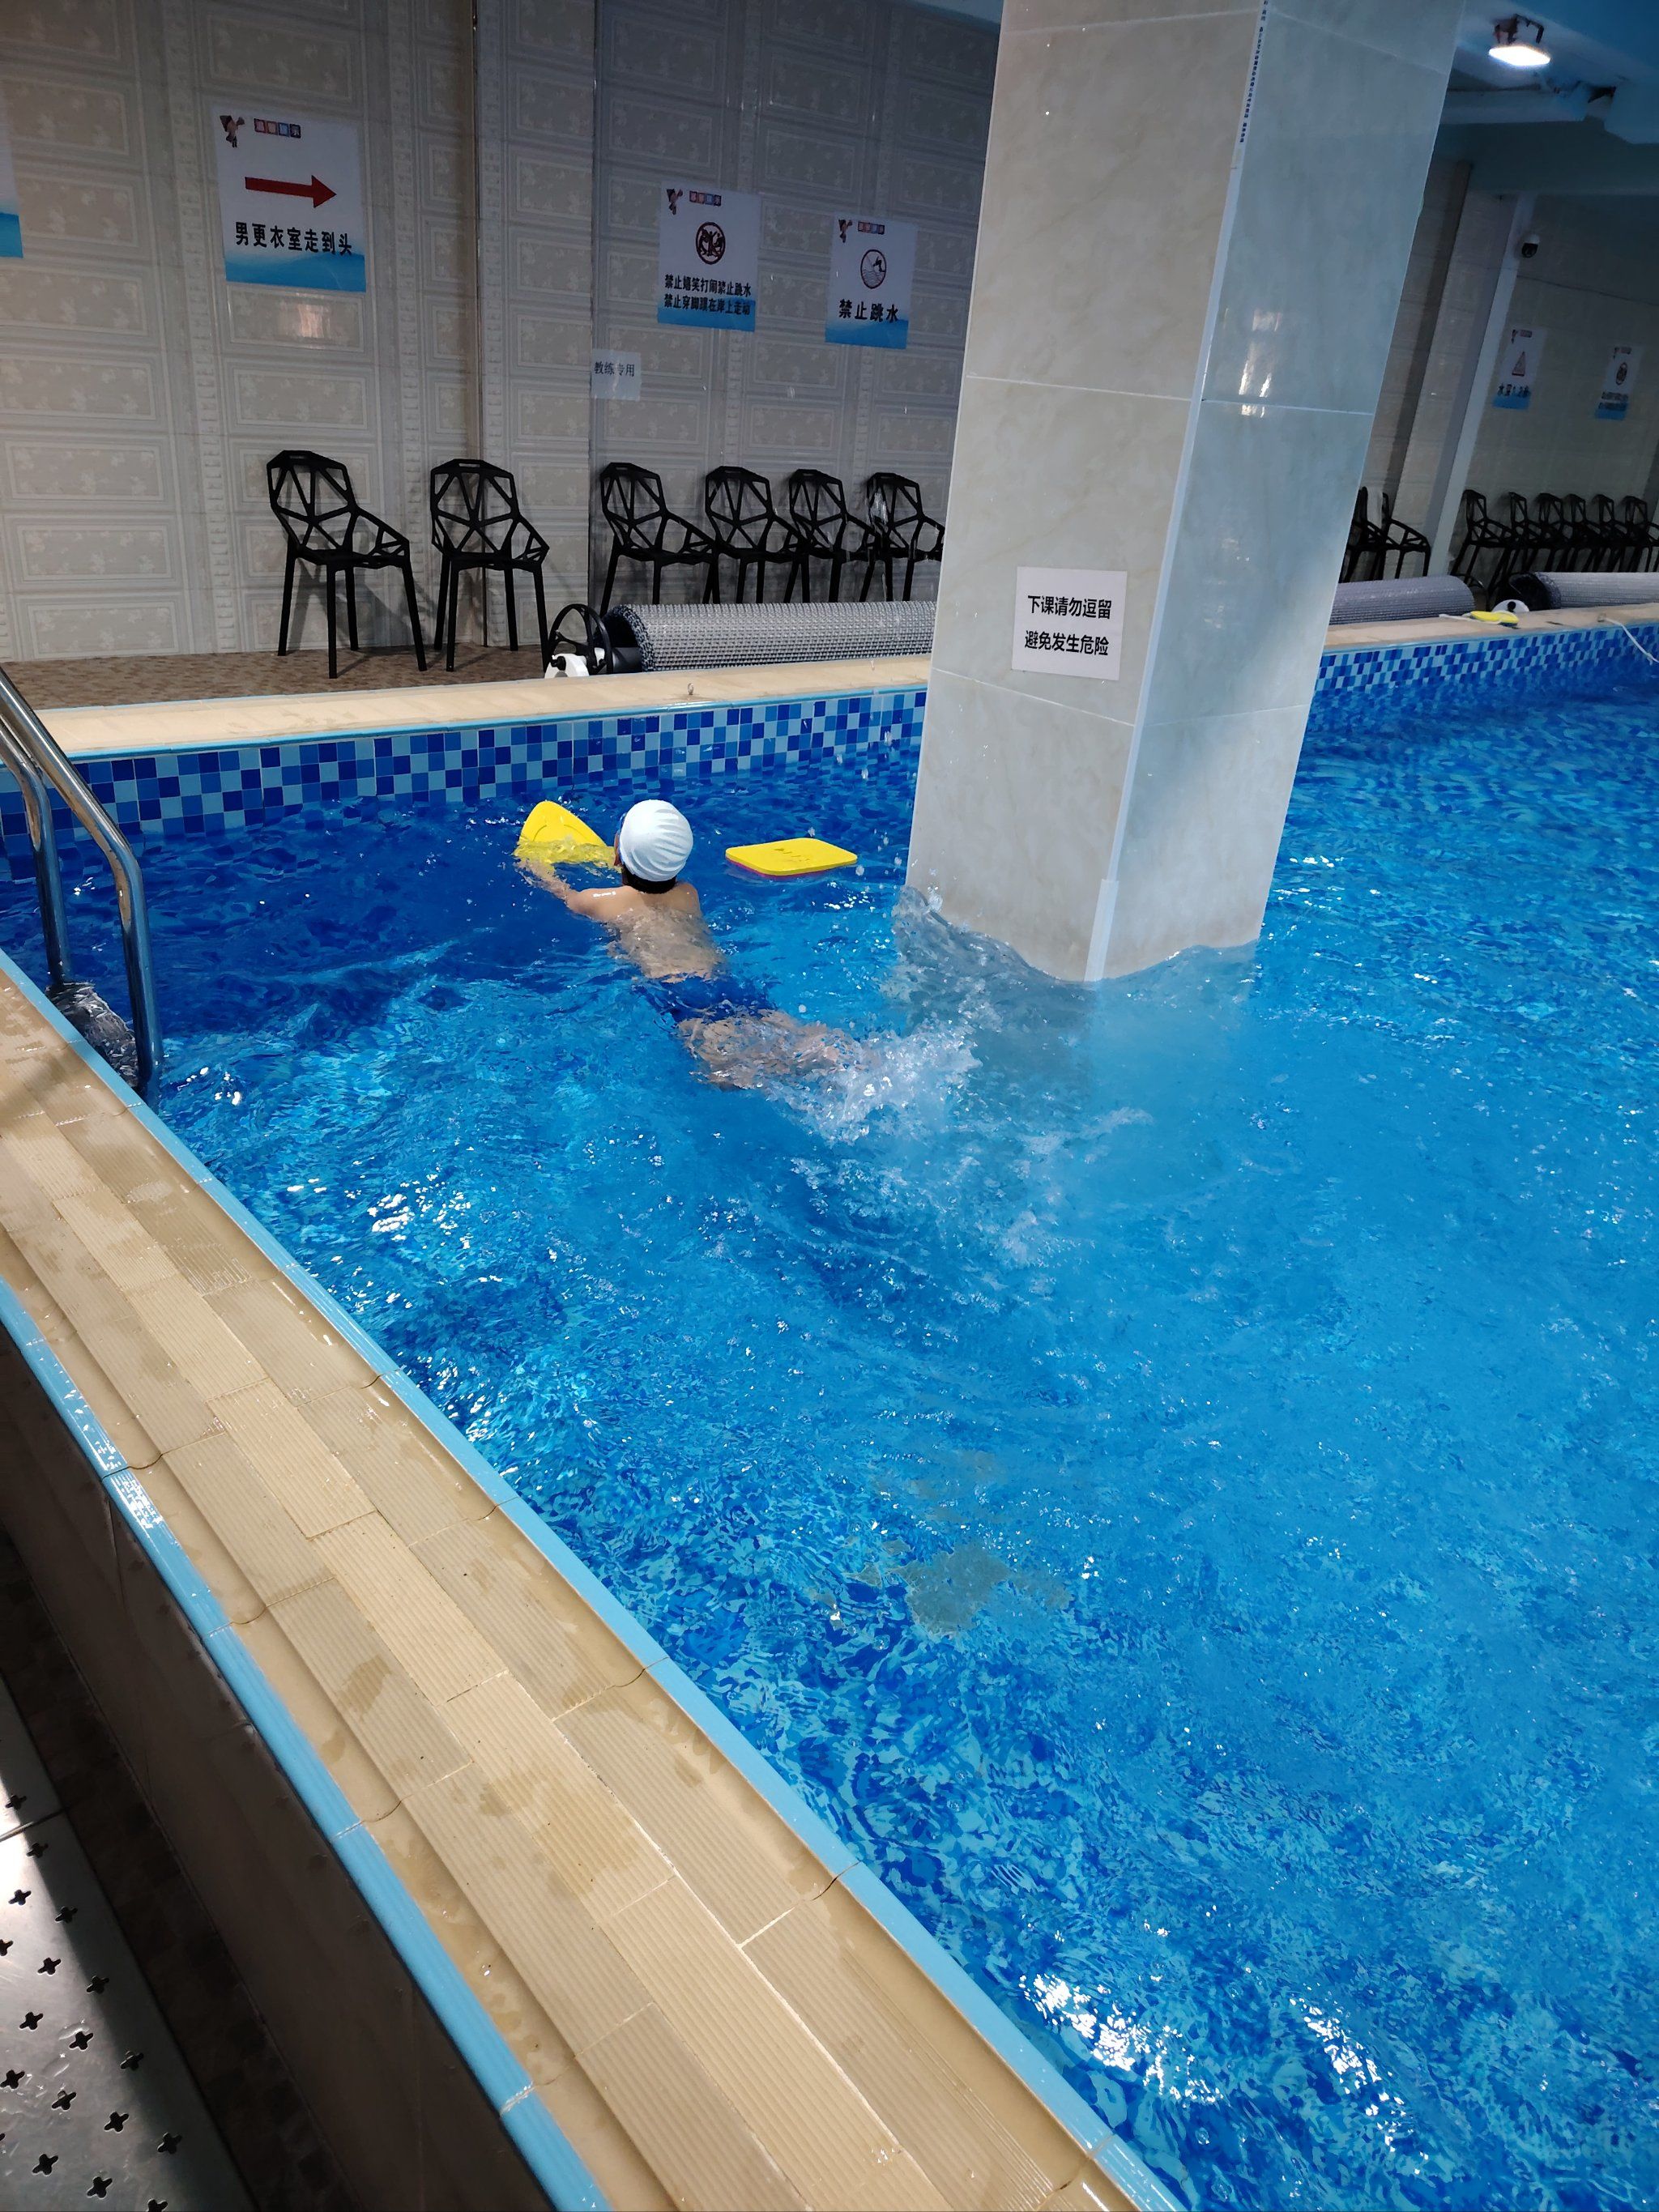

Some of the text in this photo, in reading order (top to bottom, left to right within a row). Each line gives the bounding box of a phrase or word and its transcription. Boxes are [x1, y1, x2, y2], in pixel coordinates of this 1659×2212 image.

[235, 222, 352, 255] 男更衣室走到头
[664, 274, 752, 297] 禁止嬉笑打闹禁止跳水
[839, 298, 898, 323] 禁止跳水
[594, 360, 635, 377] 教练专用
[1027, 595, 1112, 620] 下课请勿逗留
[1024, 630, 1110, 656] 避免发生危险
